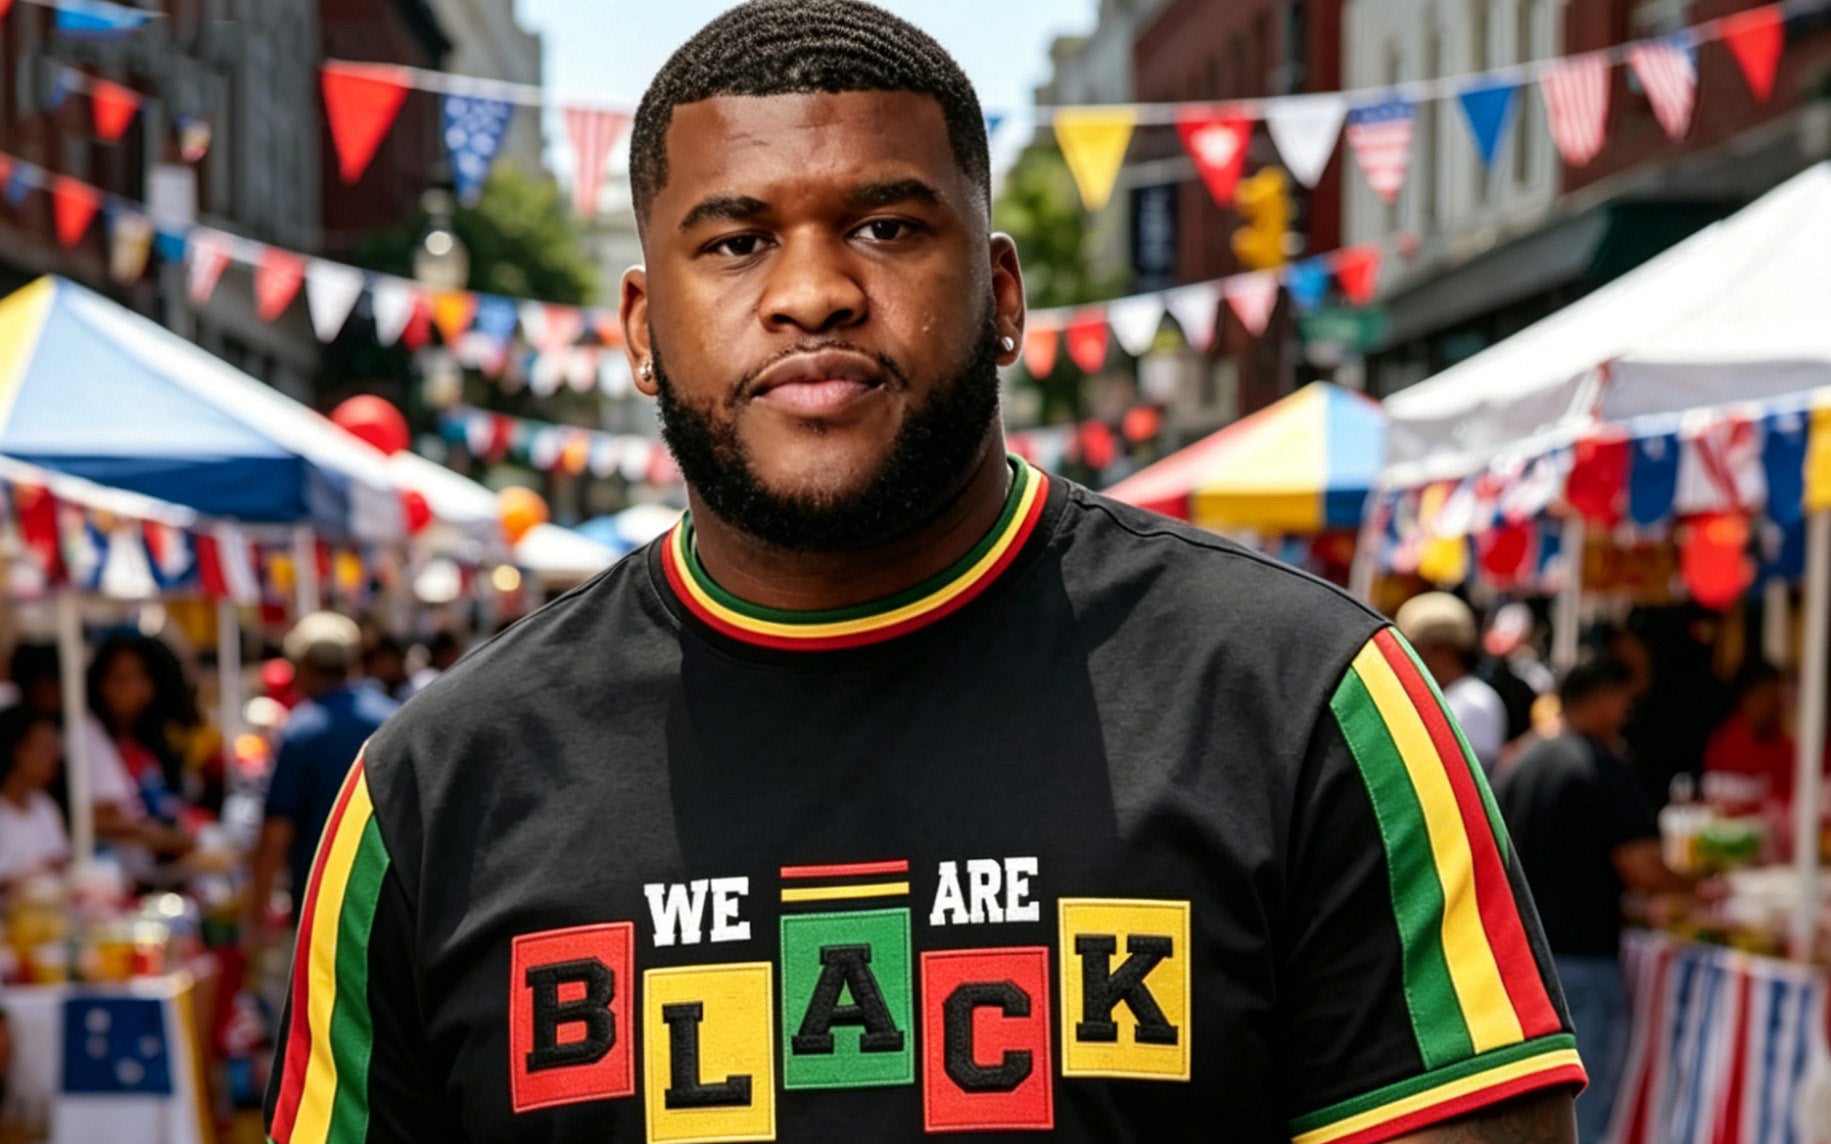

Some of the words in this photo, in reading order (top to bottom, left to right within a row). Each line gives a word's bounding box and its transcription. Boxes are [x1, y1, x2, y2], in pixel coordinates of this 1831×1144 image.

[644, 877, 751, 947] WE
[930, 857, 1040, 926] ARE
[525, 934, 1179, 1110] BLACK
